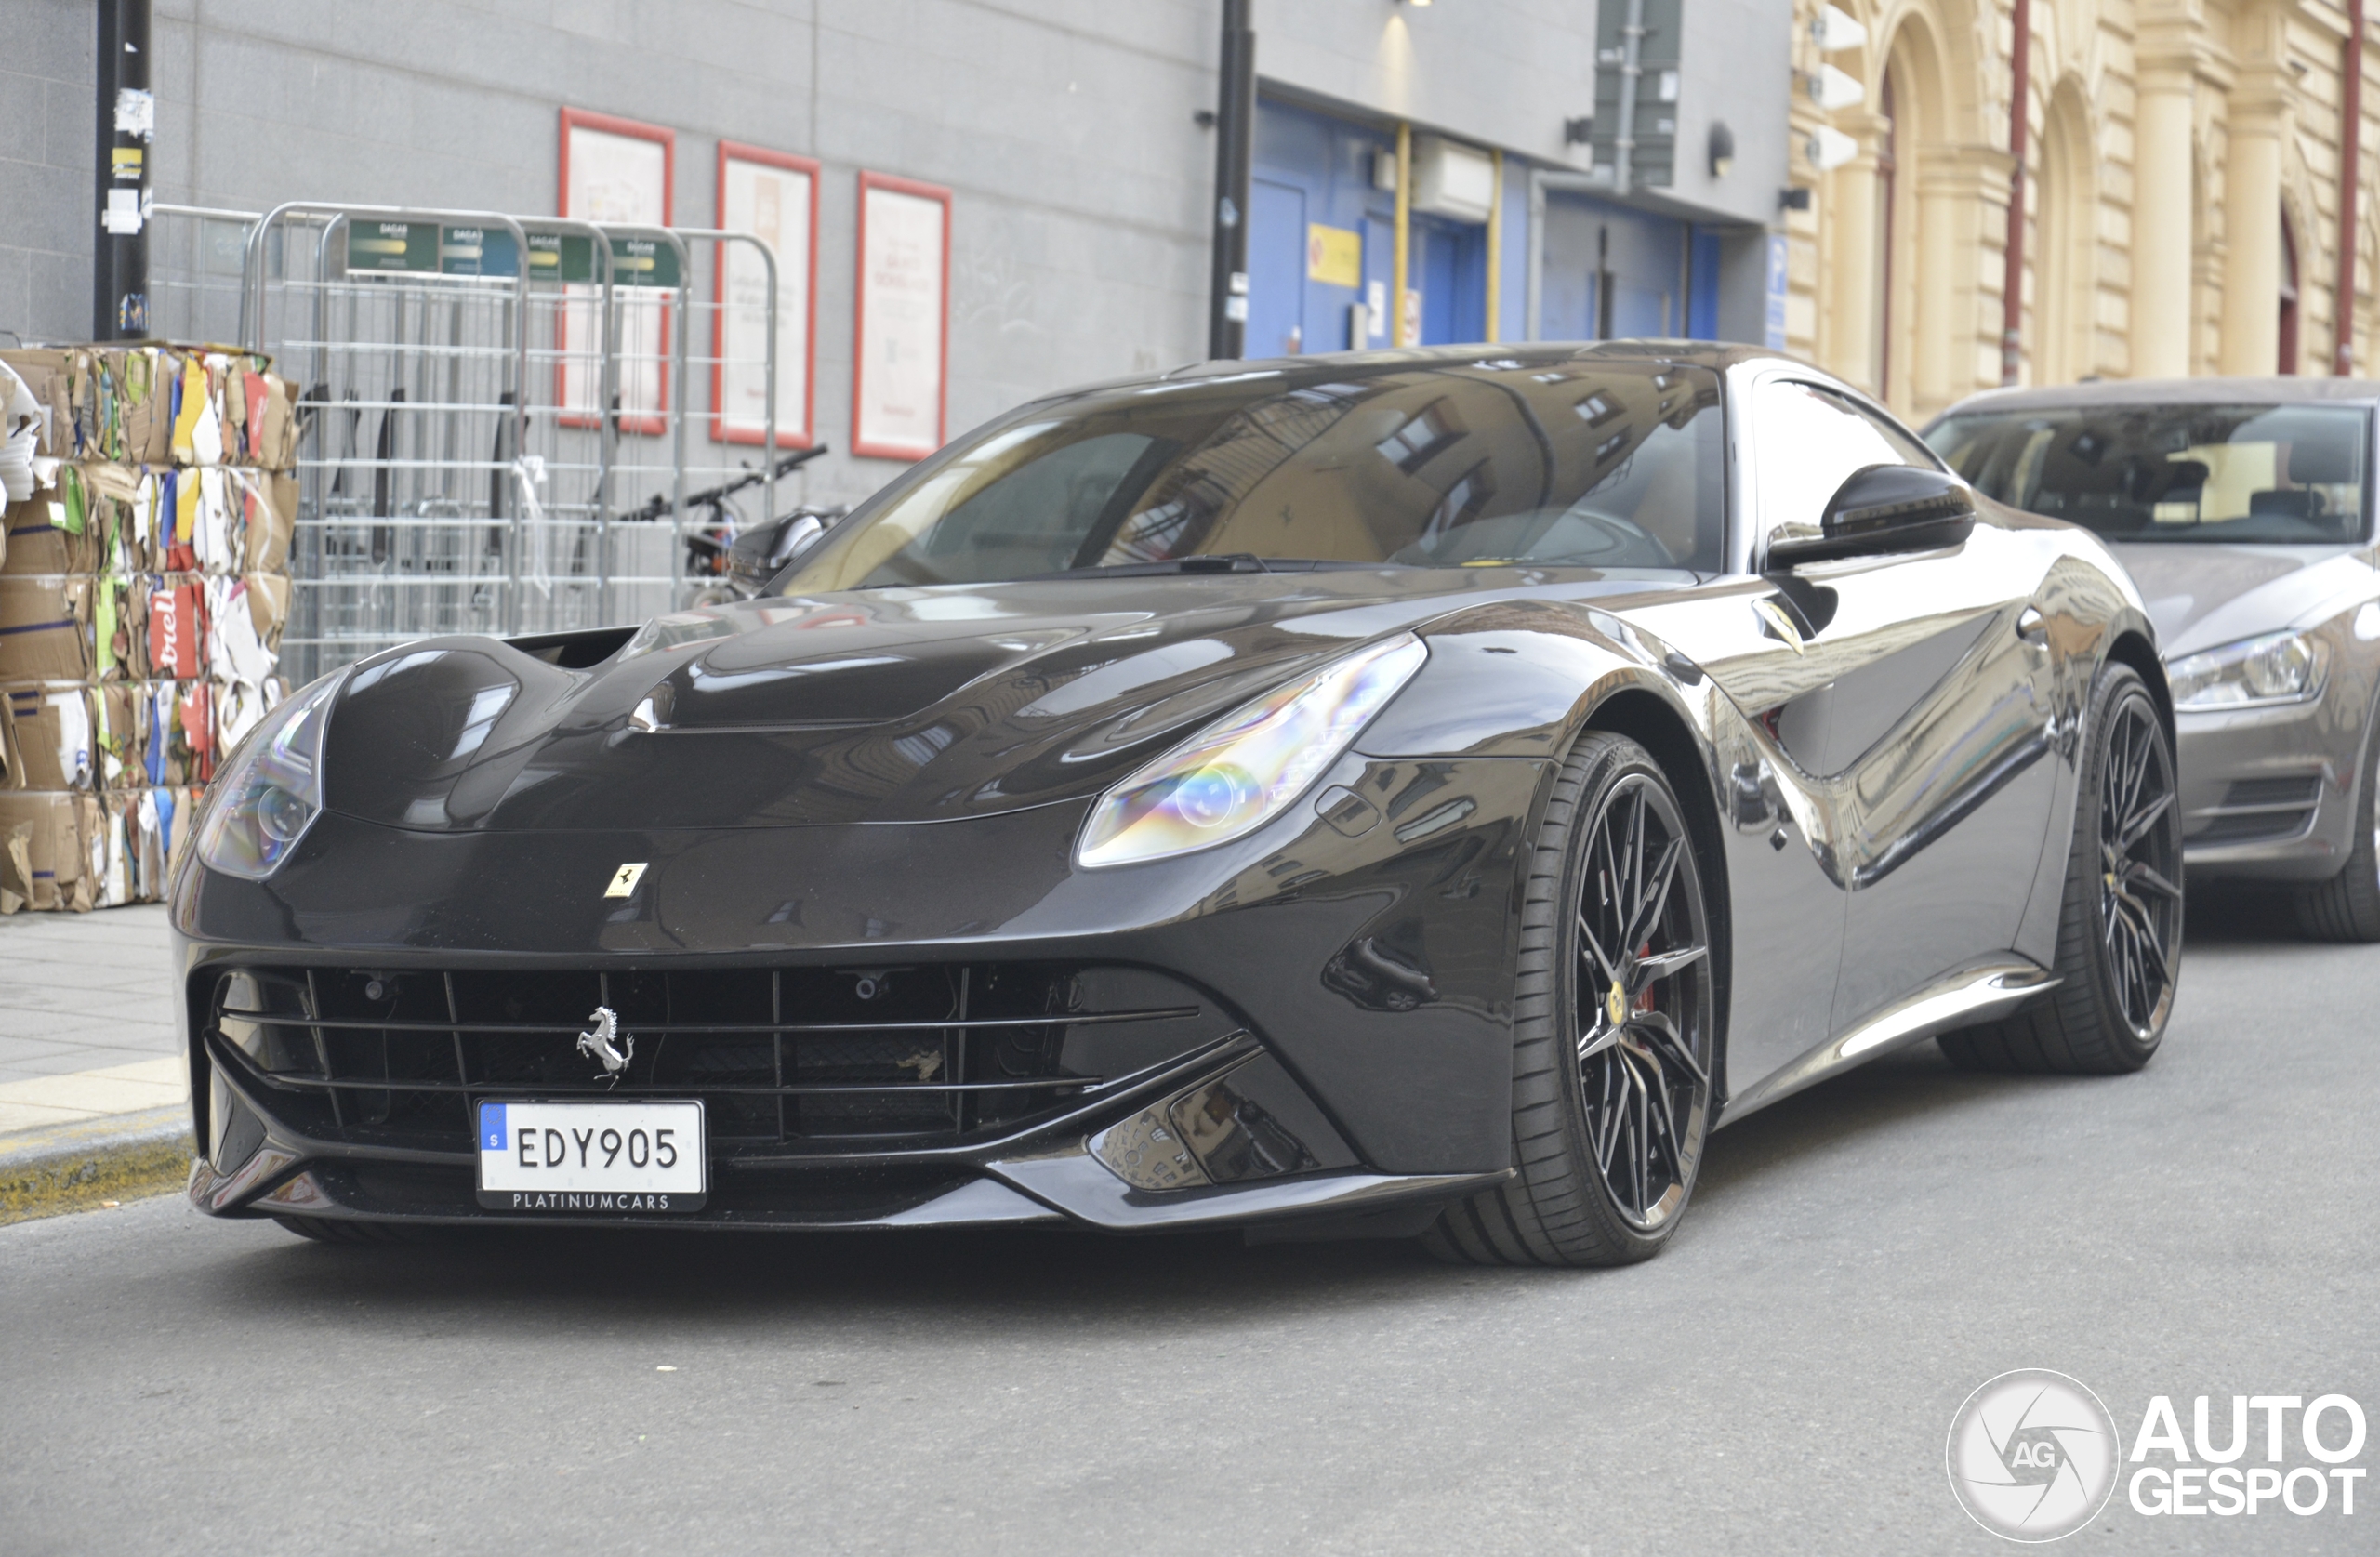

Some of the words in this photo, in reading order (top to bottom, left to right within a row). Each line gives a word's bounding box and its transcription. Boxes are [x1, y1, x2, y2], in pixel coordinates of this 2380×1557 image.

[379, 222, 408, 234] DAGAB
[490, 1134, 498, 1147] S
[518, 1128, 678, 1168] EDY905
[513, 1193, 668, 1209] PLATINUMCARS
